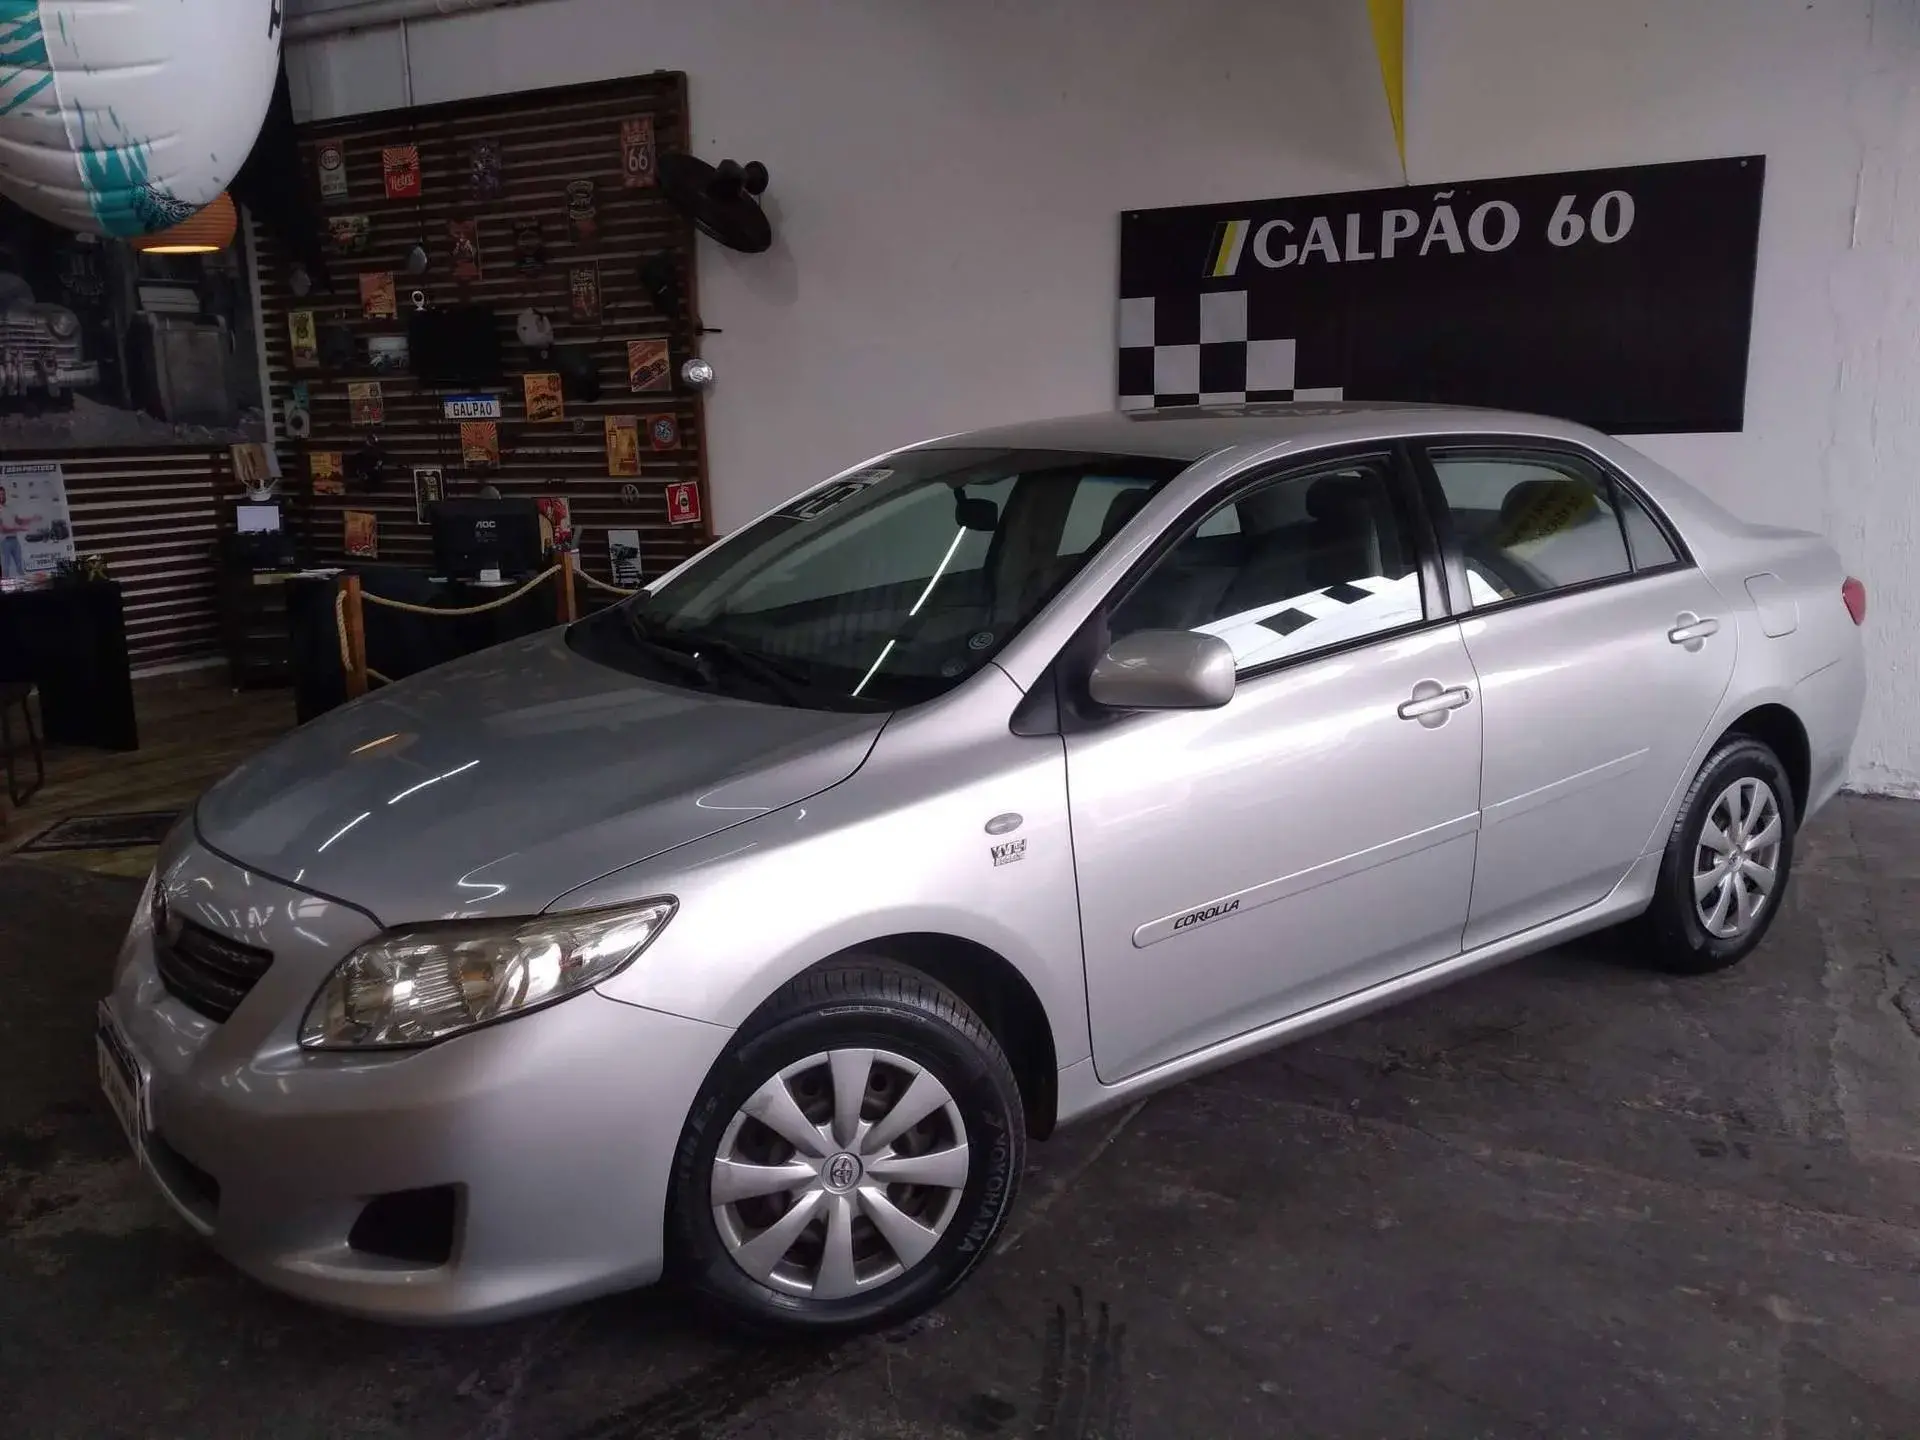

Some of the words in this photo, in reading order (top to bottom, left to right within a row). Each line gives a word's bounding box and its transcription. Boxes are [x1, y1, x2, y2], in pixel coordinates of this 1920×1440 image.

[628, 147, 648, 172] 66
[1253, 190, 1520, 268] GALPÃO
[1546, 190, 1635, 247] 60
[453, 402, 492, 416] GALPAO
[476, 520, 496, 528] AOC
[1173, 899, 1240, 930] COROLLA
[957, 1131, 1006, 1253] YOKOHAMA
